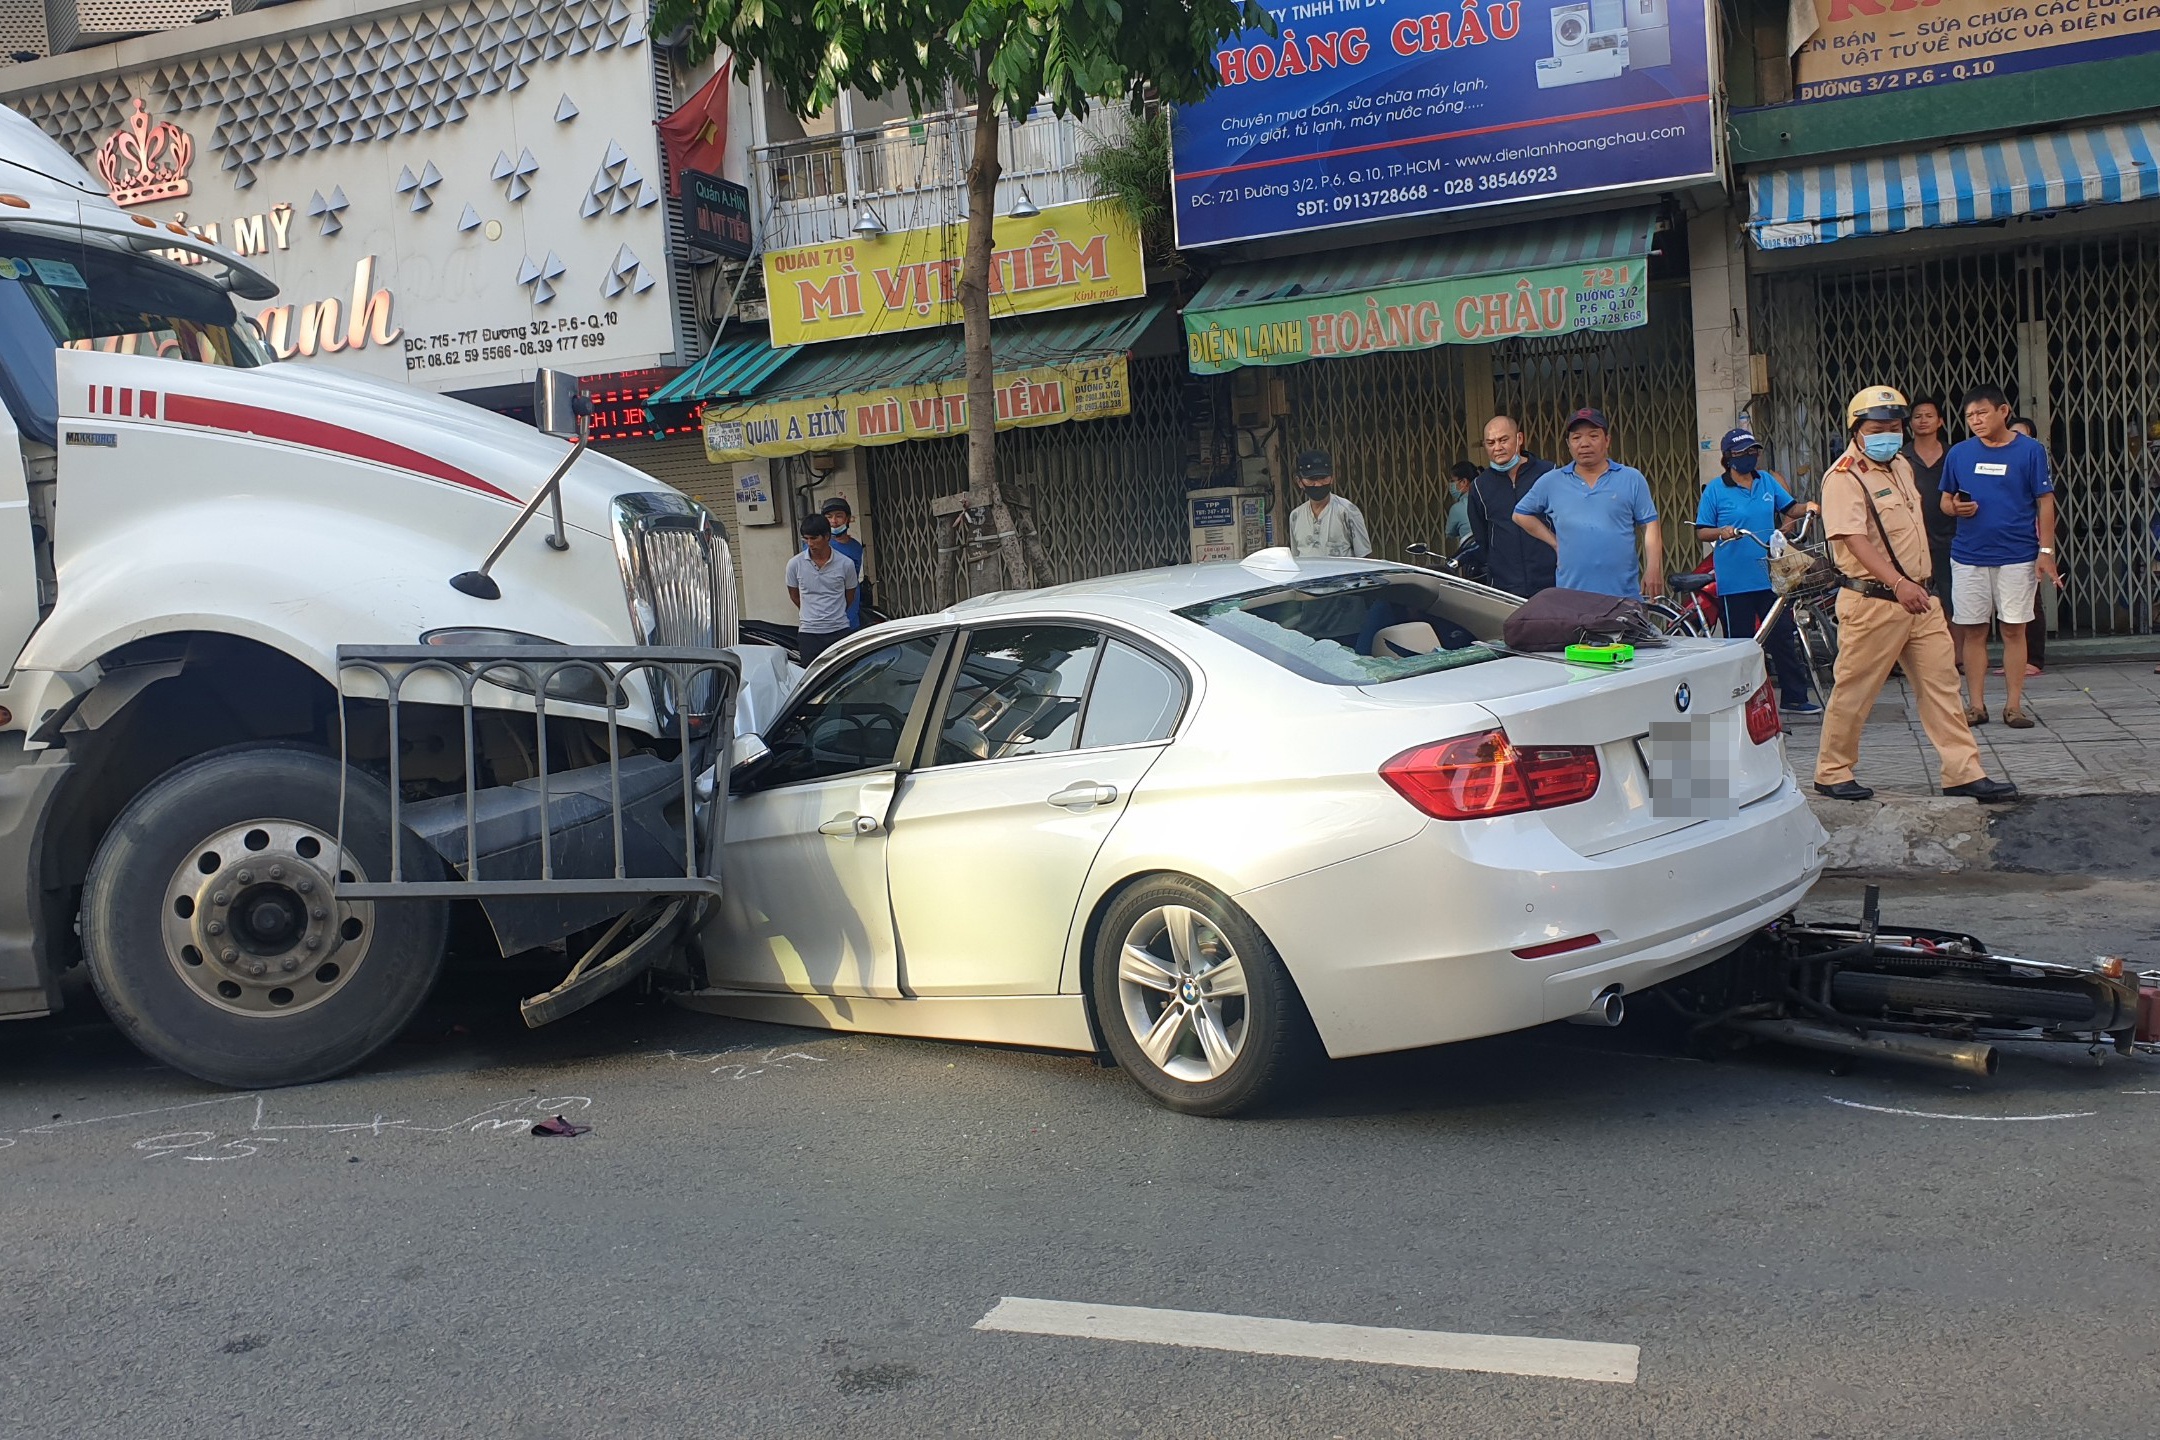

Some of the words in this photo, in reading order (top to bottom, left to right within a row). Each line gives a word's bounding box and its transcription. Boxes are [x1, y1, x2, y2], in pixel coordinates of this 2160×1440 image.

[1292, 2, 1334, 21] TNHH
[1833, 31, 1877, 49] BÁN
[1917, 15, 1961, 35] SỬA
[1967, 7, 2029, 29] CHỮA
[1216, 28, 1370, 87] HOÀNG
[1391, 0, 1522, 56] CHÂU
[1841, 47, 1883, 66] VẬT
[1888, 42, 1920, 59] TƯ
[1923, 35, 1951, 53] VỀ
[1958, 27, 2018, 50] NƯỚC
[2023, 21, 2054, 40] VÀ
[2059, 12, 2117, 34] ĐIỆN
[1801, 78, 1862, 101] ĐƯỜNG
[1867, 75, 1900, 92] 3/2
[1905, 70, 1934, 86] P.6
[1952, 60, 1995, 79] Q.10
[1221, 110, 1273, 131] Chuyên
[1276, 108, 1308, 122] mua
[1311, 101, 1343, 118] bán,
[1347, 94, 1372, 110] sửa
[1375, 89, 1413, 106] chữa
[1417, 82, 1450, 102] máy
[1452, 77, 1489, 96] lạnh,
[1226, 130, 1257, 148] máy
[1260, 126, 1290, 146] giặt,
[1295, 119, 1309, 137] tủ
[1312, 116, 1346, 136] lạnh,
[1350, 111, 1382, 130] máy
[1385, 105, 1423, 122] nước
[1191, 193, 1216, 208] ĐC:
[1219, 187, 1240, 204] 721
[1244, 181, 1290, 200] Đường
[1292, 177, 1319, 193] 3/2,
[1321, 172, 1346, 189] P.6,
[1348, 166, 1386, 185] Q.10,
[1387, 158, 1442, 179] TP.HCM
[1455, 123, 1686, 169] www.dienlanhhoangchau.com
[696, 181, 720, 203] Quán
[1296, 198, 1330, 217] SĐT:
[1333, 184, 1429, 212] 0913728668
[1444, 177, 1474, 196] 028
[1478, 165, 1558, 192] 38546923
[234, 202, 296, 257] MỸ
[774, 244, 823, 273] QUÁN
[825, 245, 855, 266] 719
[1582, 265, 1629, 288] 721
[795, 264, 865, 323] MÌ
[872, 257, 964, 316] VỊT
[1073, 288, 1098, 303] Kính
[1099, 286, 1119, 300] mời
[1575, 288, 1615, 303] ĐƯỜNG
[1619, 286, 1638, 298] 3/2
[1580, 303, 1598, 314] P.6
[1609, 299, 1635, 311] Q.10
[404, 337, 427, 352] ĐC:
[430, 333, 449, 349] 715
[458, 330, 478, 346] 717
[530, 319, 550, 336] 3/2
[558, 316, 578, 332] P.6
[588, 311, 618, 329] Q.10
[1188, 326, 1239, 364] ĐIỆN
[1244, 320, 1302, 361] LẠNH
[1307, 296, 1443, 356] HOÀNG
[1453, 277, 1568, 339] CHÂU
[1573, 310, 1642, 328] 0913.728.668
[406, 355, 426, 371] ĐT:
[428, 352, 461, 368] 08.62
[465, 347, 479, 363] 59
[556, 335, 578, 351] 177
[581, 332, 605, 348] 699
[1078, 366, 1111, 383] 719
[1106, 380, 1120, 390] 3/2
[746, 414, 779, 447] QUÁN
[785, 415, 806, 441] A
[807, 403, 847, 438] HÌN
[857, 393, 903, 438] MÌ
[909, 393, 965, 435] VỊT
[994, 377, 1064, 420] IỀM
